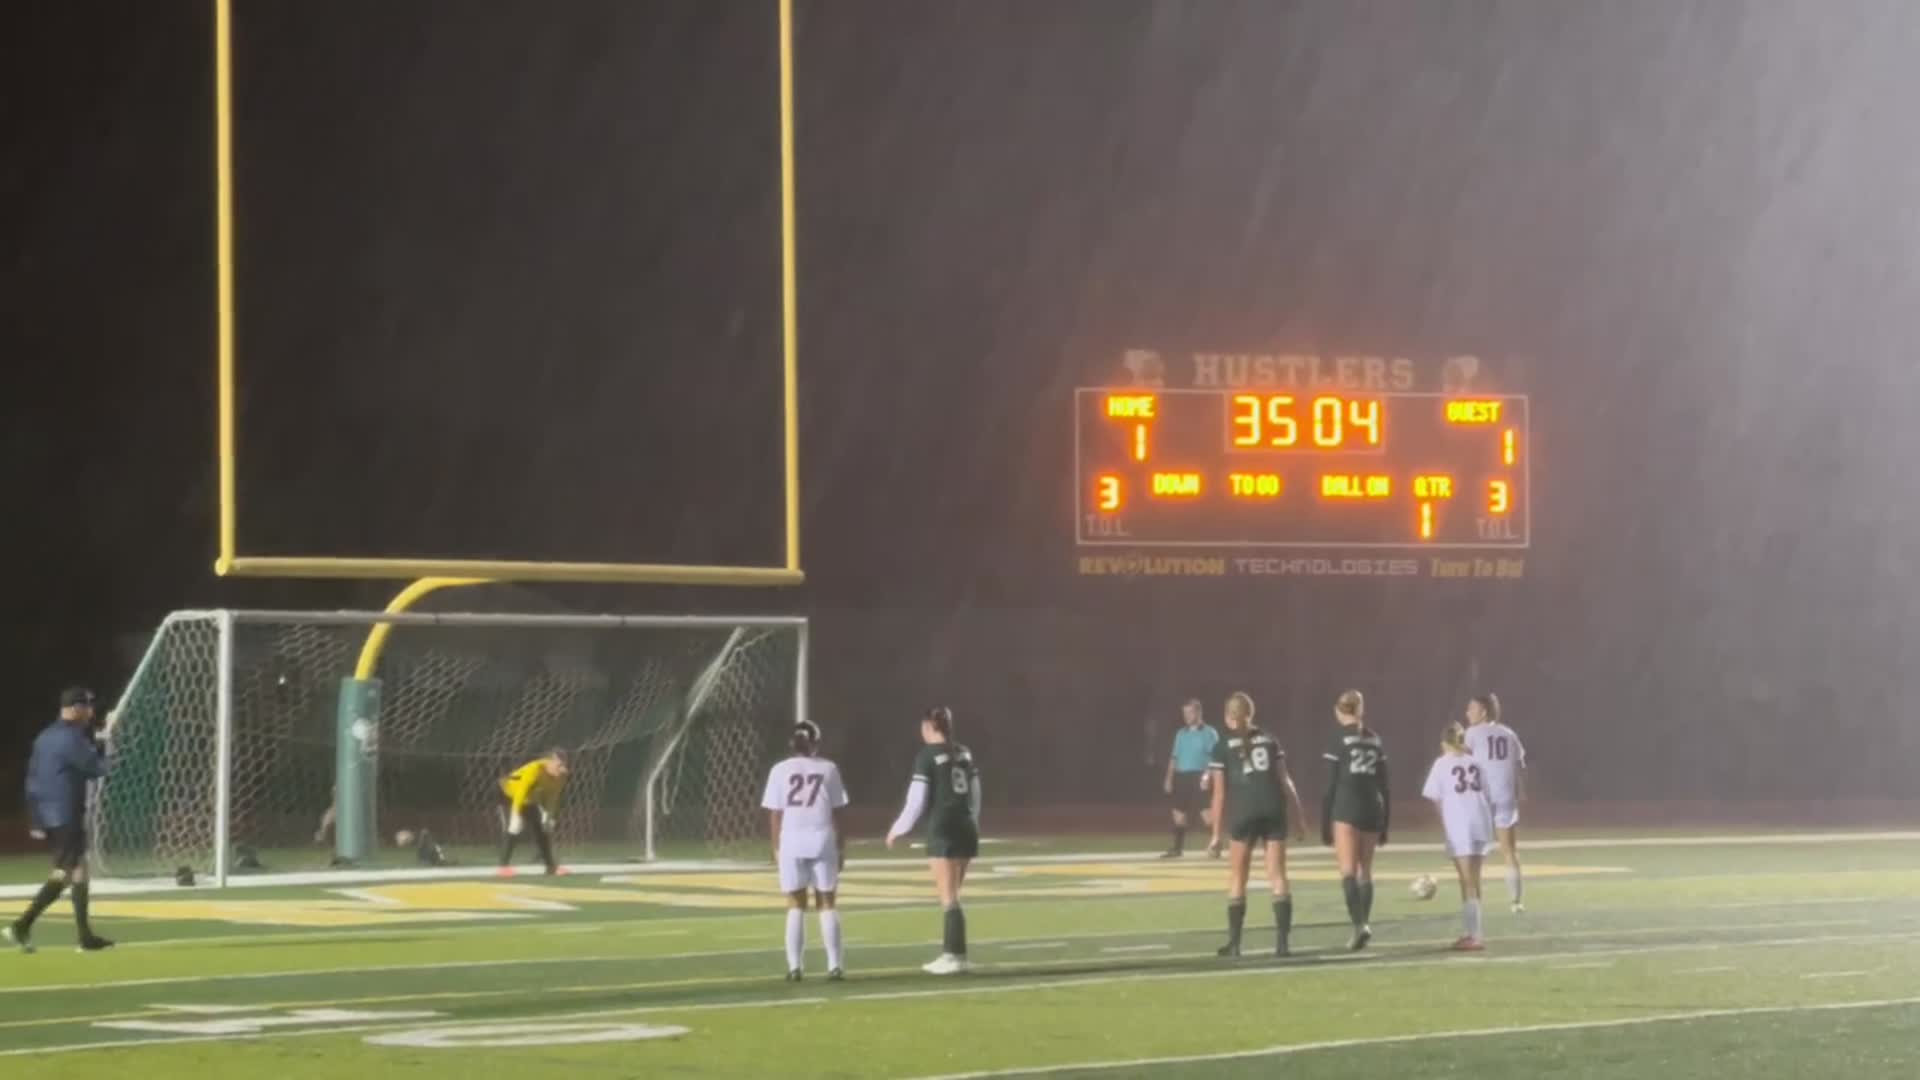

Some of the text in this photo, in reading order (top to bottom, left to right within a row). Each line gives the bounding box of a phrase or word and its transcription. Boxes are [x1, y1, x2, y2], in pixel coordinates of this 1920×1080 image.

[1194, 354, 1413, 390] HUSTLERS
[1108, 396, 1154, 417] HOME
[1234, 395, 1378, 446] 35 04
[1135, 424, 1146, 461] 1
[1503, 429, 1515, 465] 1
[1101, 476, 1119, 509] 3
[1153, 474, 1200, 495] DOWN
[1229, 474, 1255, 496] TO
[1414, 476, 1451, 497] QTR
[1489, 480, 1508, 513] 3
[1420, 501, 1432, 539] 1
[1234, 558, 1418, 576] TECHNOLOGIES
[1349, 748, 1377, 774] 22
[1488, 735, 1509, 761] 10
[787, 773, 825, 808] 27
[1452, 765, 1482, 794] 33
